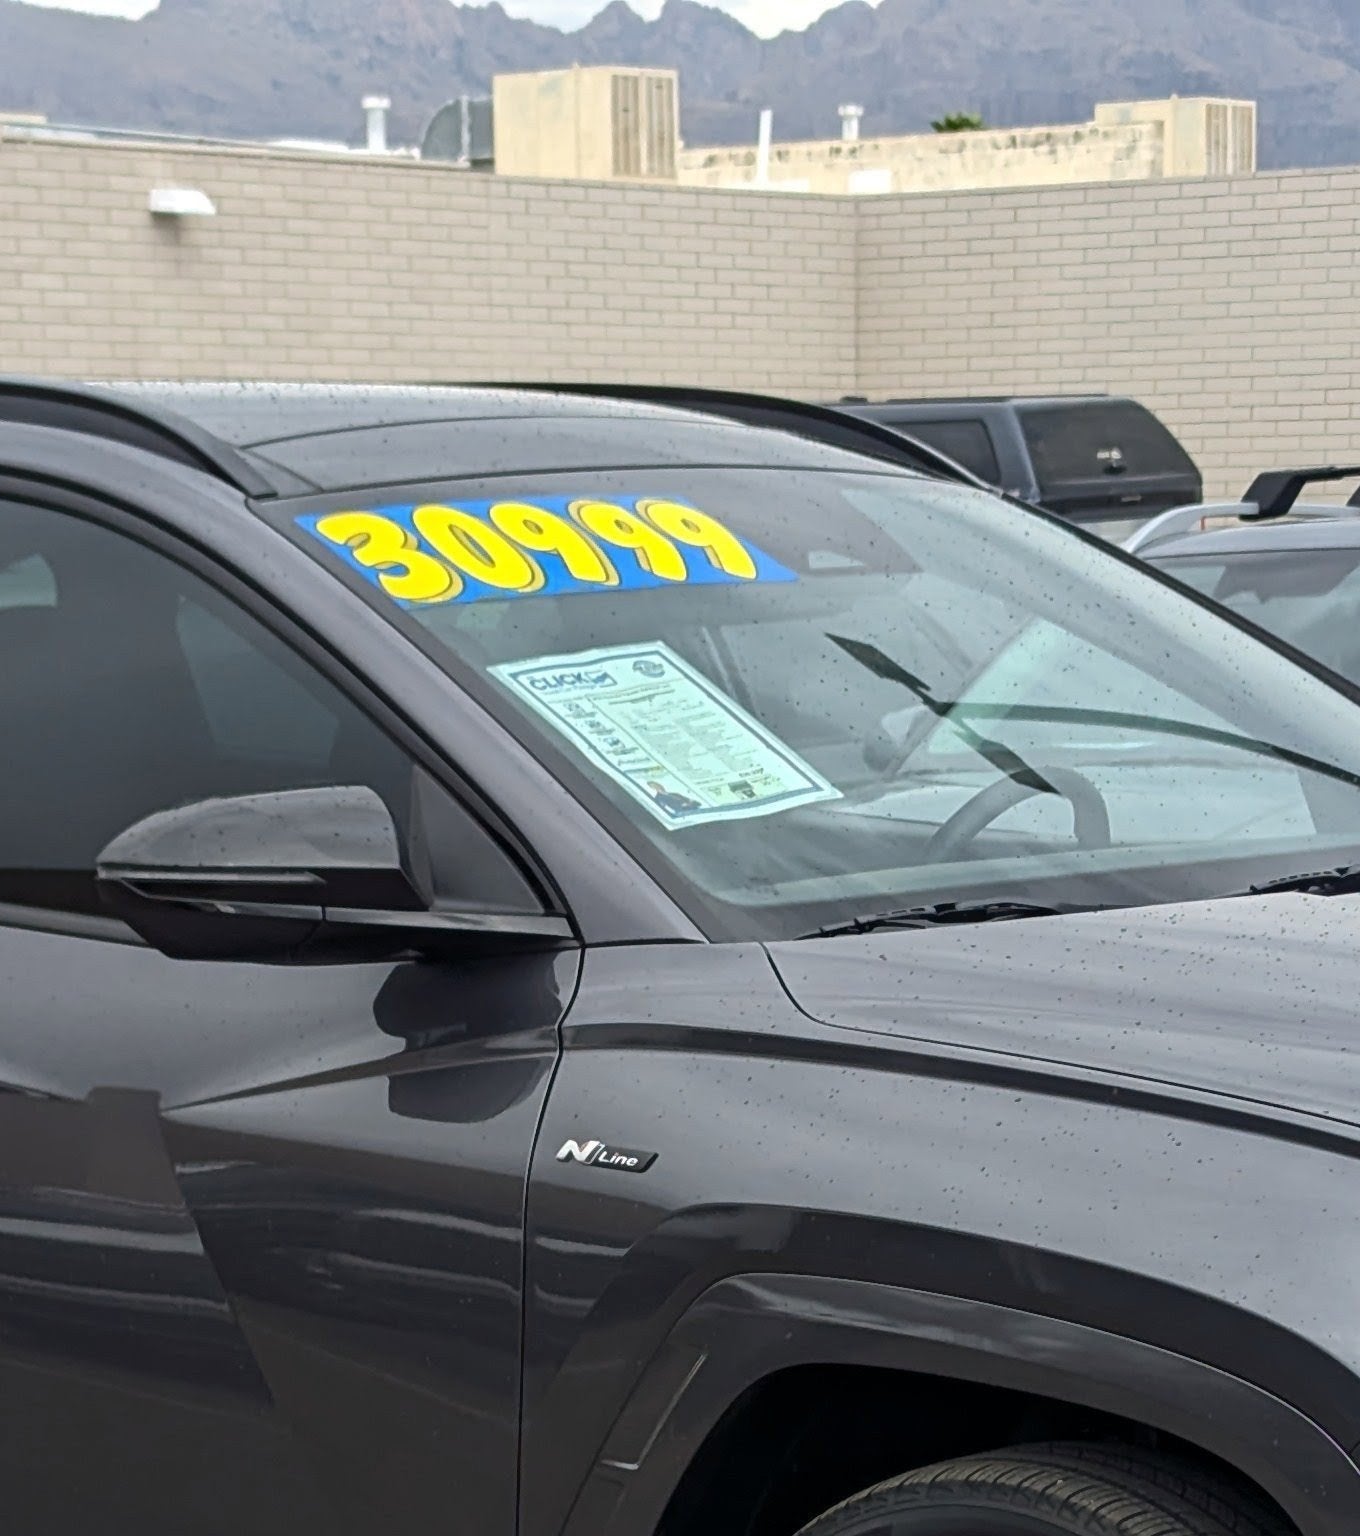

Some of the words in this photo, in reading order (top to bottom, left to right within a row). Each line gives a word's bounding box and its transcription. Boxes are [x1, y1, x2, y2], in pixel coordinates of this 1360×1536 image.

[316, 499, 757, 602] 30999
[529, 671, 587, 691] CLICK
[555, 1139, 605, 1165] N
[597, 1151, 639, 1167] Line
